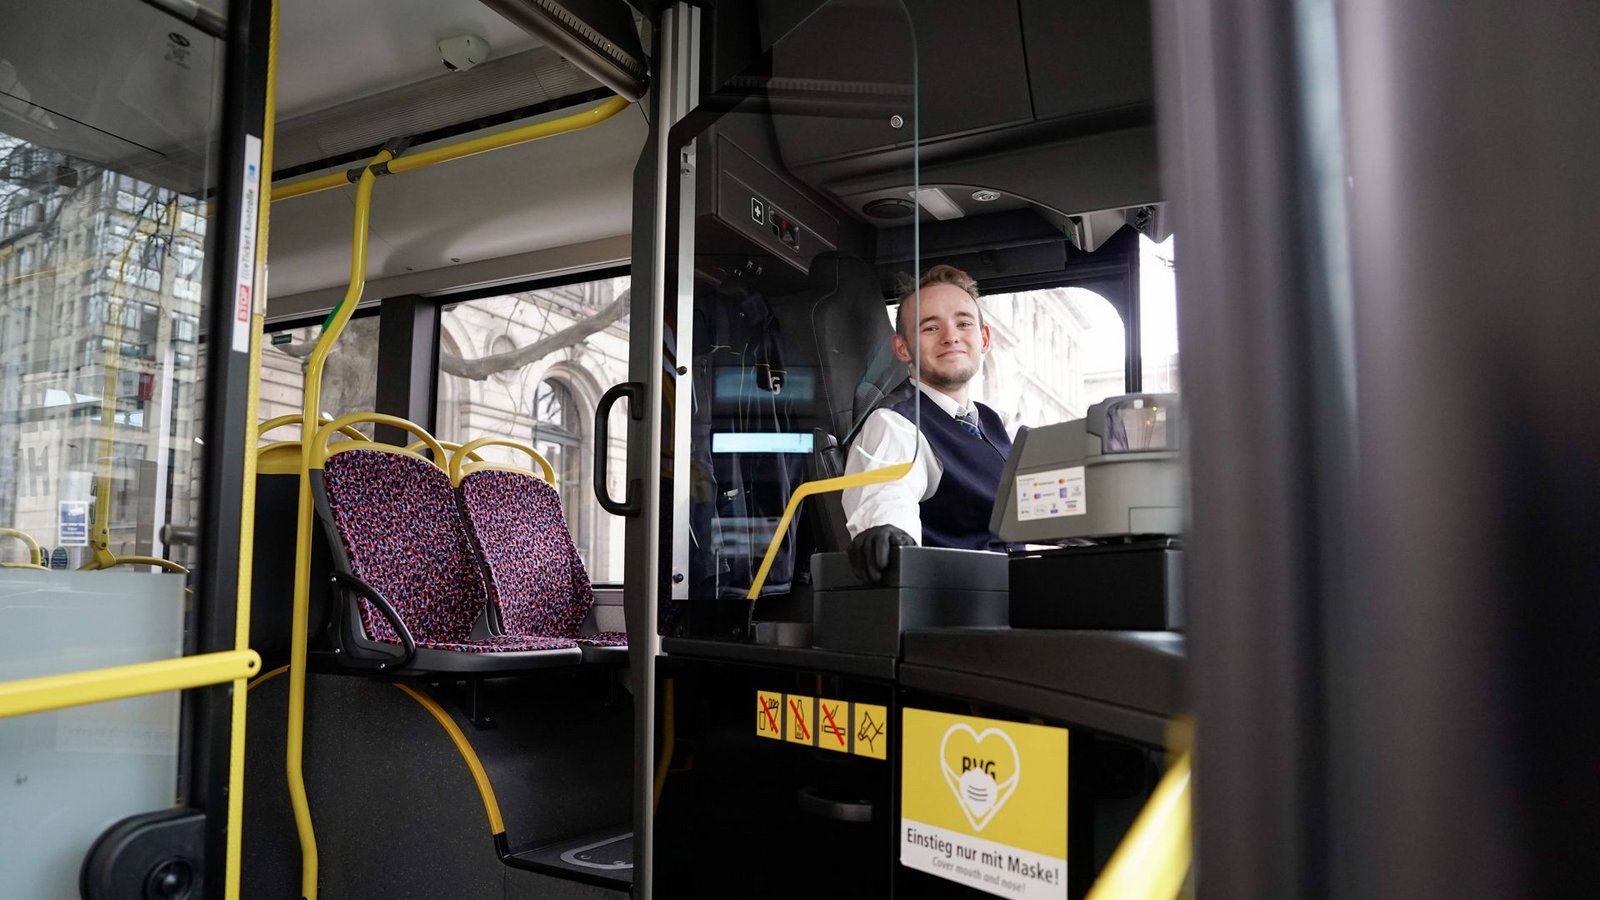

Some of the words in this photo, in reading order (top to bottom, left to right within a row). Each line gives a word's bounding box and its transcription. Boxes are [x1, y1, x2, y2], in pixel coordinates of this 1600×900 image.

[907, 828, 953, 858] Einstieg
[956, 845, 977, 861] nur
[981, 850, 1003, 870] mit
[1008, 856, 1059, 885] Maske!
[932, 856, 954, 870] Cover
[955, 864, 982, 880] mouth
[984, 873, 1000, 886] and
[1001, 878, 1026, 893] nose!
